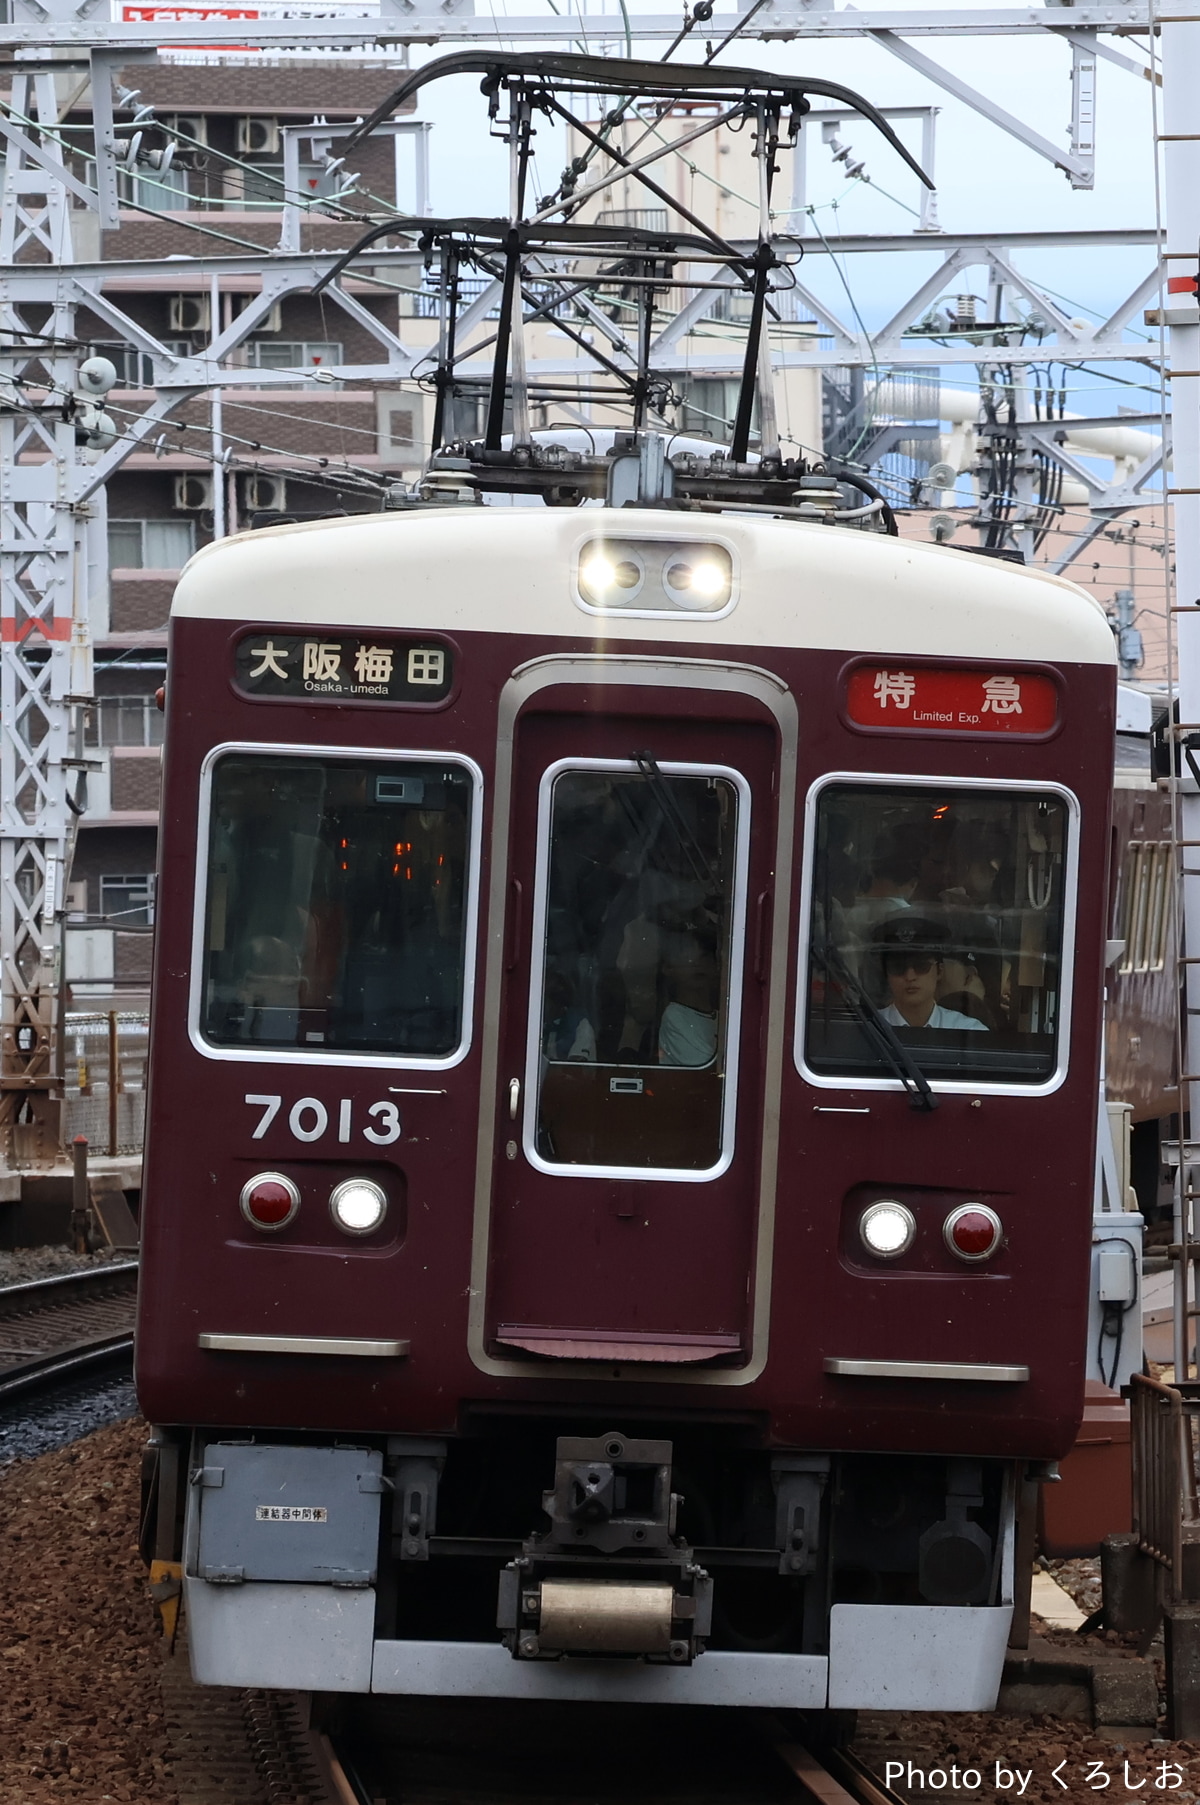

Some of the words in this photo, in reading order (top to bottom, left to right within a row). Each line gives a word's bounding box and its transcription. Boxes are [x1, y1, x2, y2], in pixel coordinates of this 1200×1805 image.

[250, 641, 445, 685] 大阪梅田
[304, 680, 389, 695] Osaka-umeda
[873, 671, 1023, 714] 特急
[913, 710, 953, 722] Limited
[958, 712, 981, 724] Exp.
[245, 1094, 401, 1145] 7013
